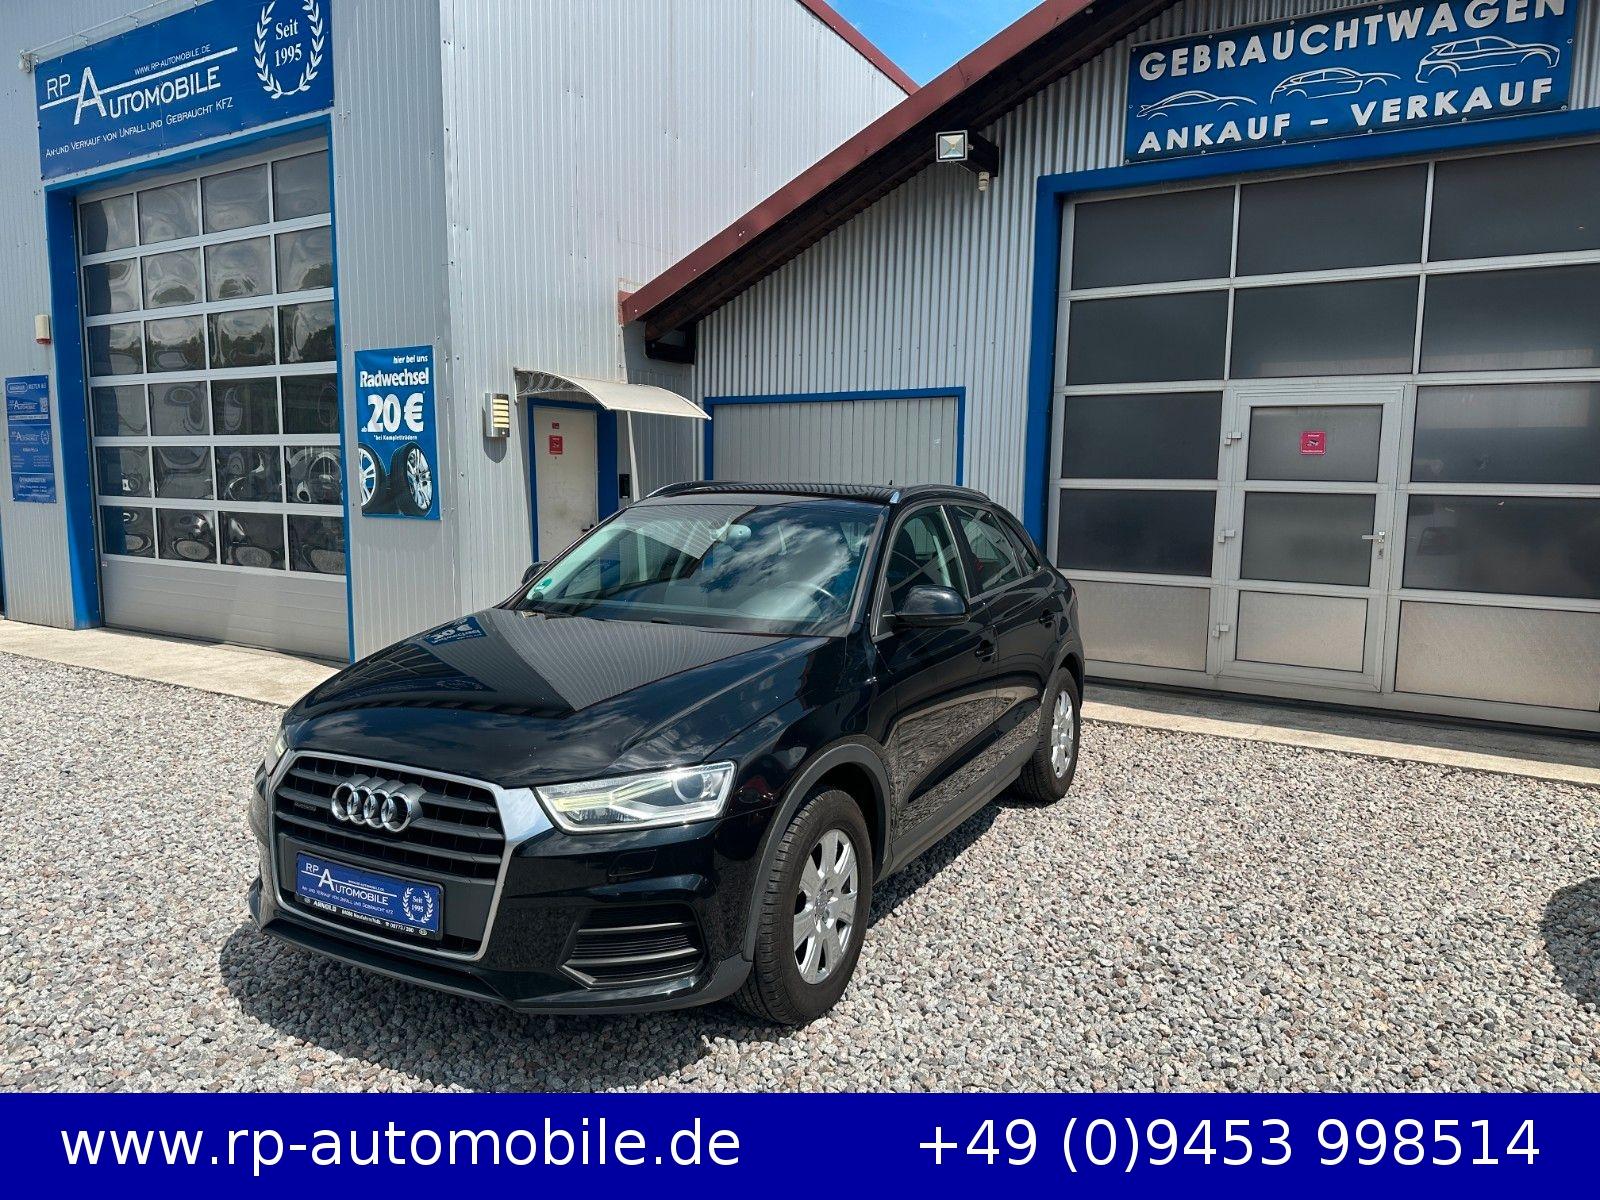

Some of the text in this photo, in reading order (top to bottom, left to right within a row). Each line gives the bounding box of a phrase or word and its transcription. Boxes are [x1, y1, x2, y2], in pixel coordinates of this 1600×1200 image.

[275, 18, 299, 40] Seit
[1139, 0, 1565, 81] GEBRAUCHTWAGEN
[134, 44, 211, 75] WWW.RP-AUTOMOBILE.DE
[274, 42, 302, 67] 1995
[46, 66, 221, 126] RP AUTOMOBILE
[71, 136, 101, 151] VERKAUF
[102, 131, 117, 142] VON
[119, 124, 146, 138] UNFALL
[147, 119, 163, 131] UND
[165, 104, 214, 125] GEBRAUCHT
[215, 97, 235, 112] KFZ
[1137, 112, 1291, 154] ANKAUF
[1350, 77, 1553, 127] VERKAUF
[393, 355, 405, 364] hier
[416, 355, 429, 363] uns
[359, 366, 430, 388] Radwechsel
[305, 862, 320, 874] RP
[318, 868, 389, 906] AUTOMOBILE
[411, 904, 424, 913] 1995
